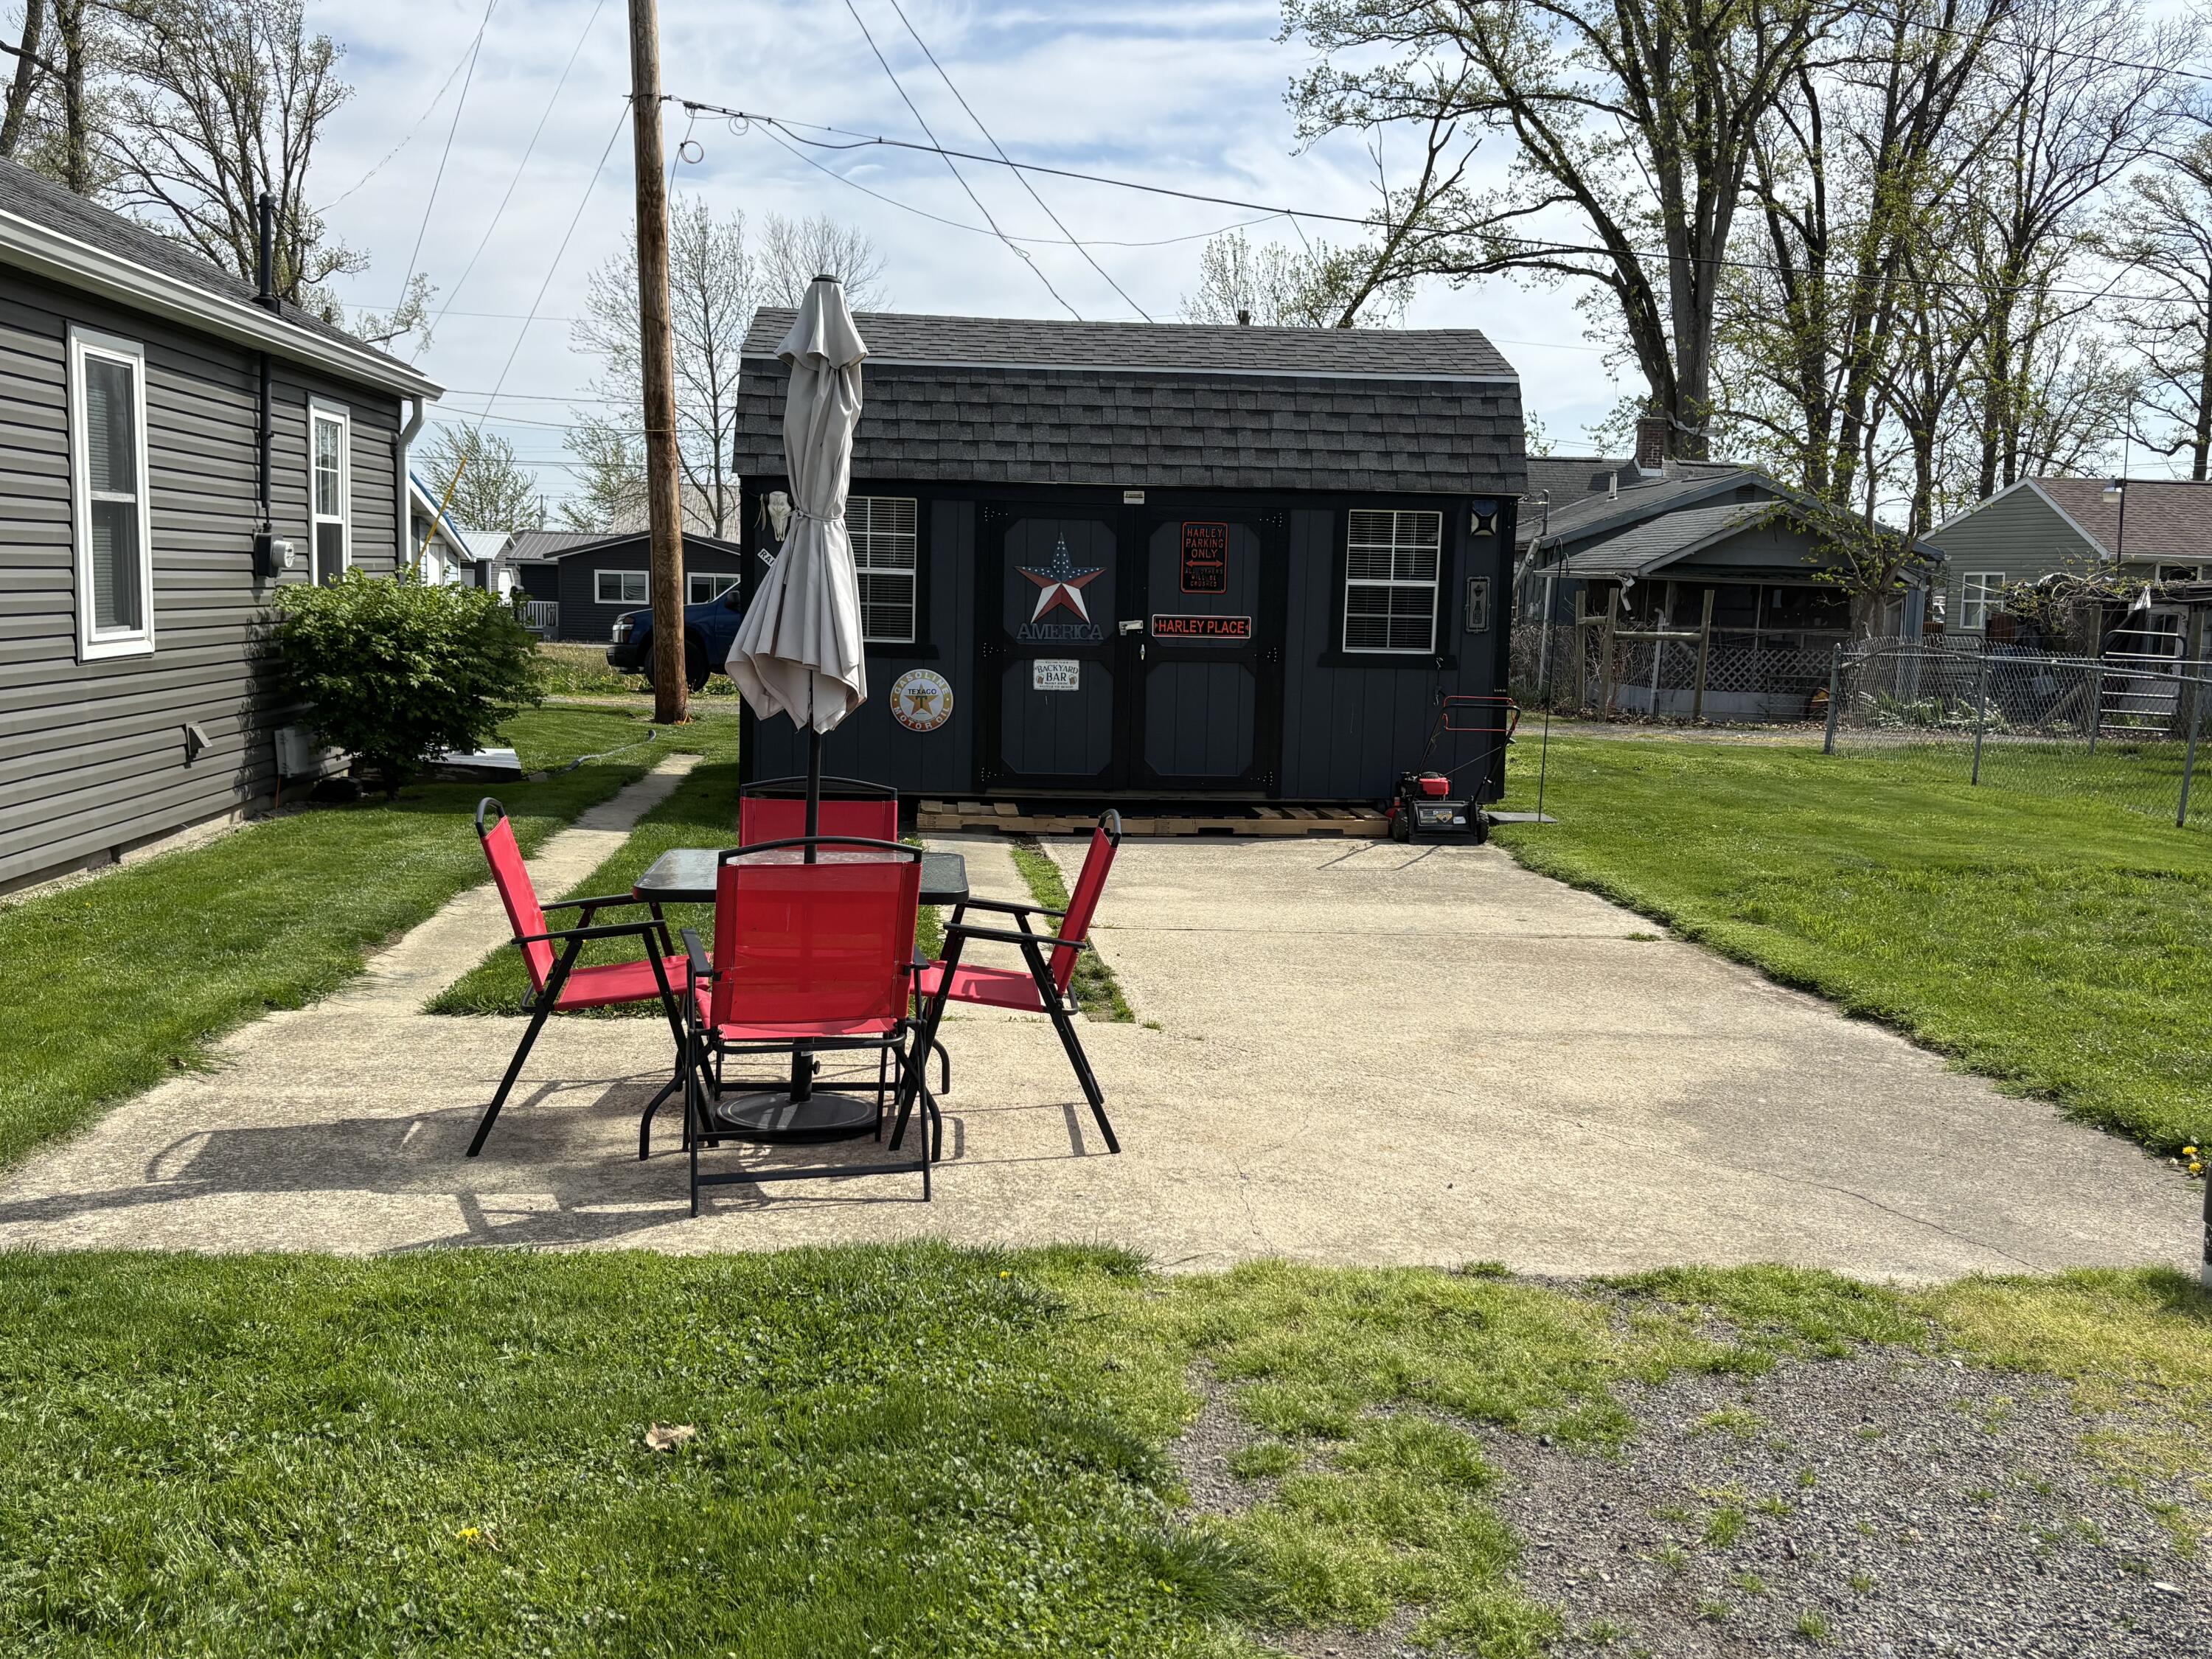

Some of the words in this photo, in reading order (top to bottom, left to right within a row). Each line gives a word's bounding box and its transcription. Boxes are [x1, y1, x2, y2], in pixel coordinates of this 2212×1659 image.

[1187, 527, 1222, 538] HARLEY
[1186, 538, 1224, 549] PARKING
[1191, 549, 1218, 558] ONLY
[1016, 622, 1104, 640] AMERICA
[1158, 619, 1205, 633] HARLEY
[1207, 621, 1245, 633] PLACE
[1034, 664, 1079, 673] BACKYARD
[1046, 672, 1067, 681] BAR
[894, 671, 950, 694] GASOLINE
[894, 706, 933, 729] MOTOR
[936, 707, 950, 723] OIL
